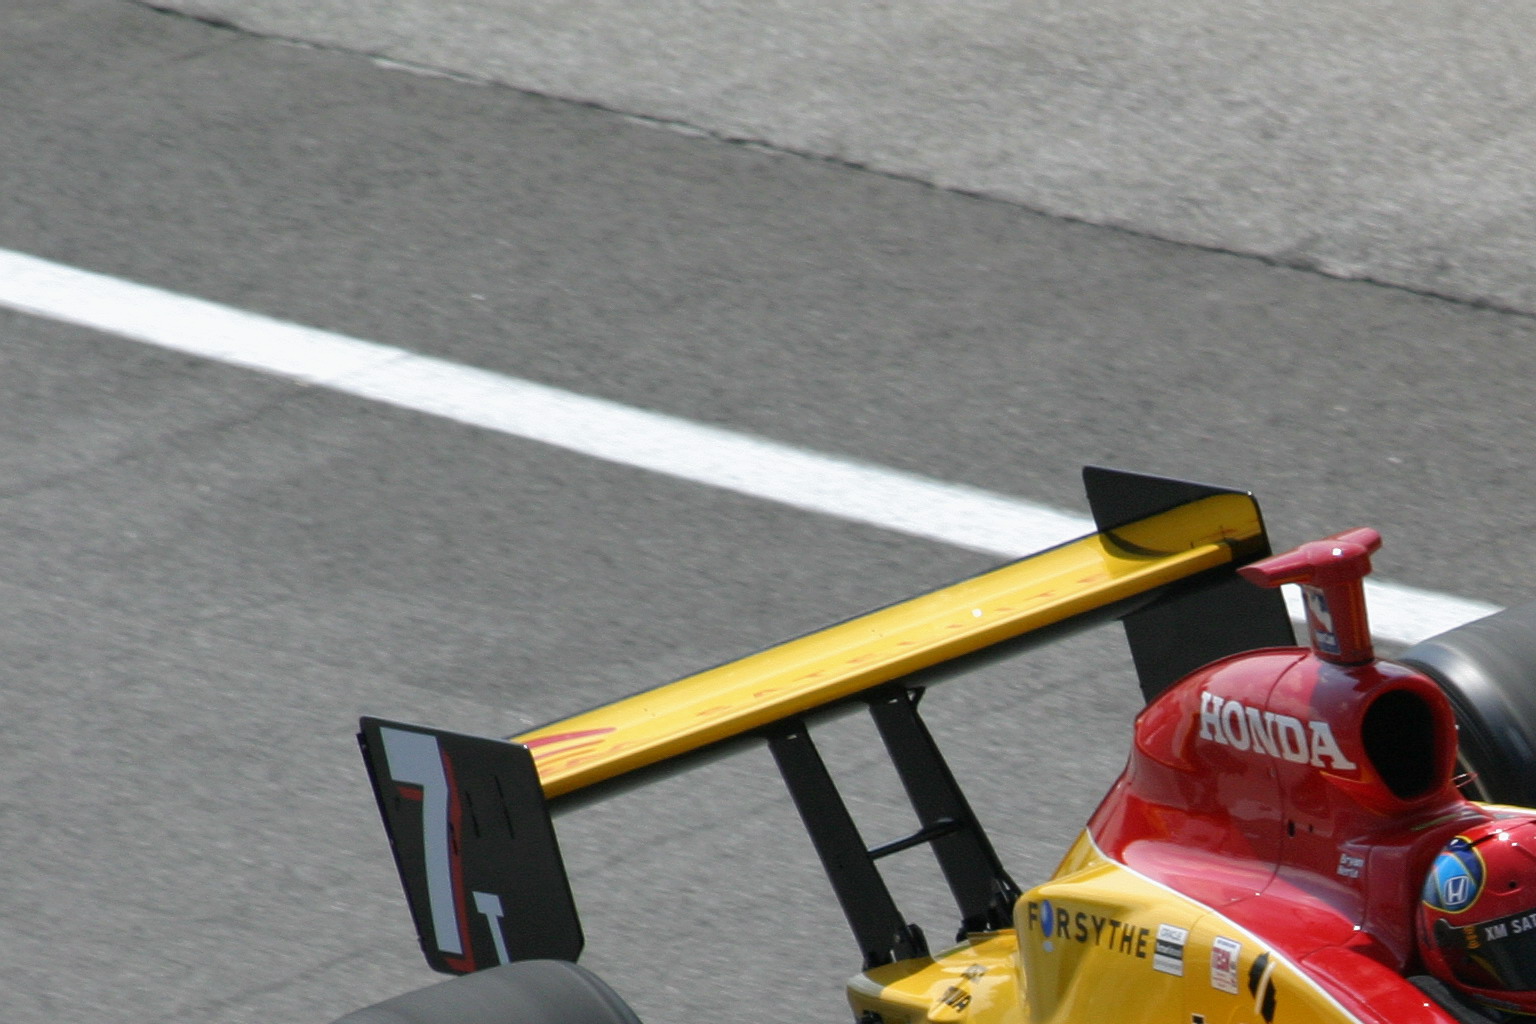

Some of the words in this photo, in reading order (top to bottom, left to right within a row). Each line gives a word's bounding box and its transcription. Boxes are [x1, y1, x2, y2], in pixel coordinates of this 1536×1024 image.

[1200, 690, 1357, 771] HONDA
[379, 726, 466, 956] 7
[1028, 899, 1150, 959] FORSYTHE
